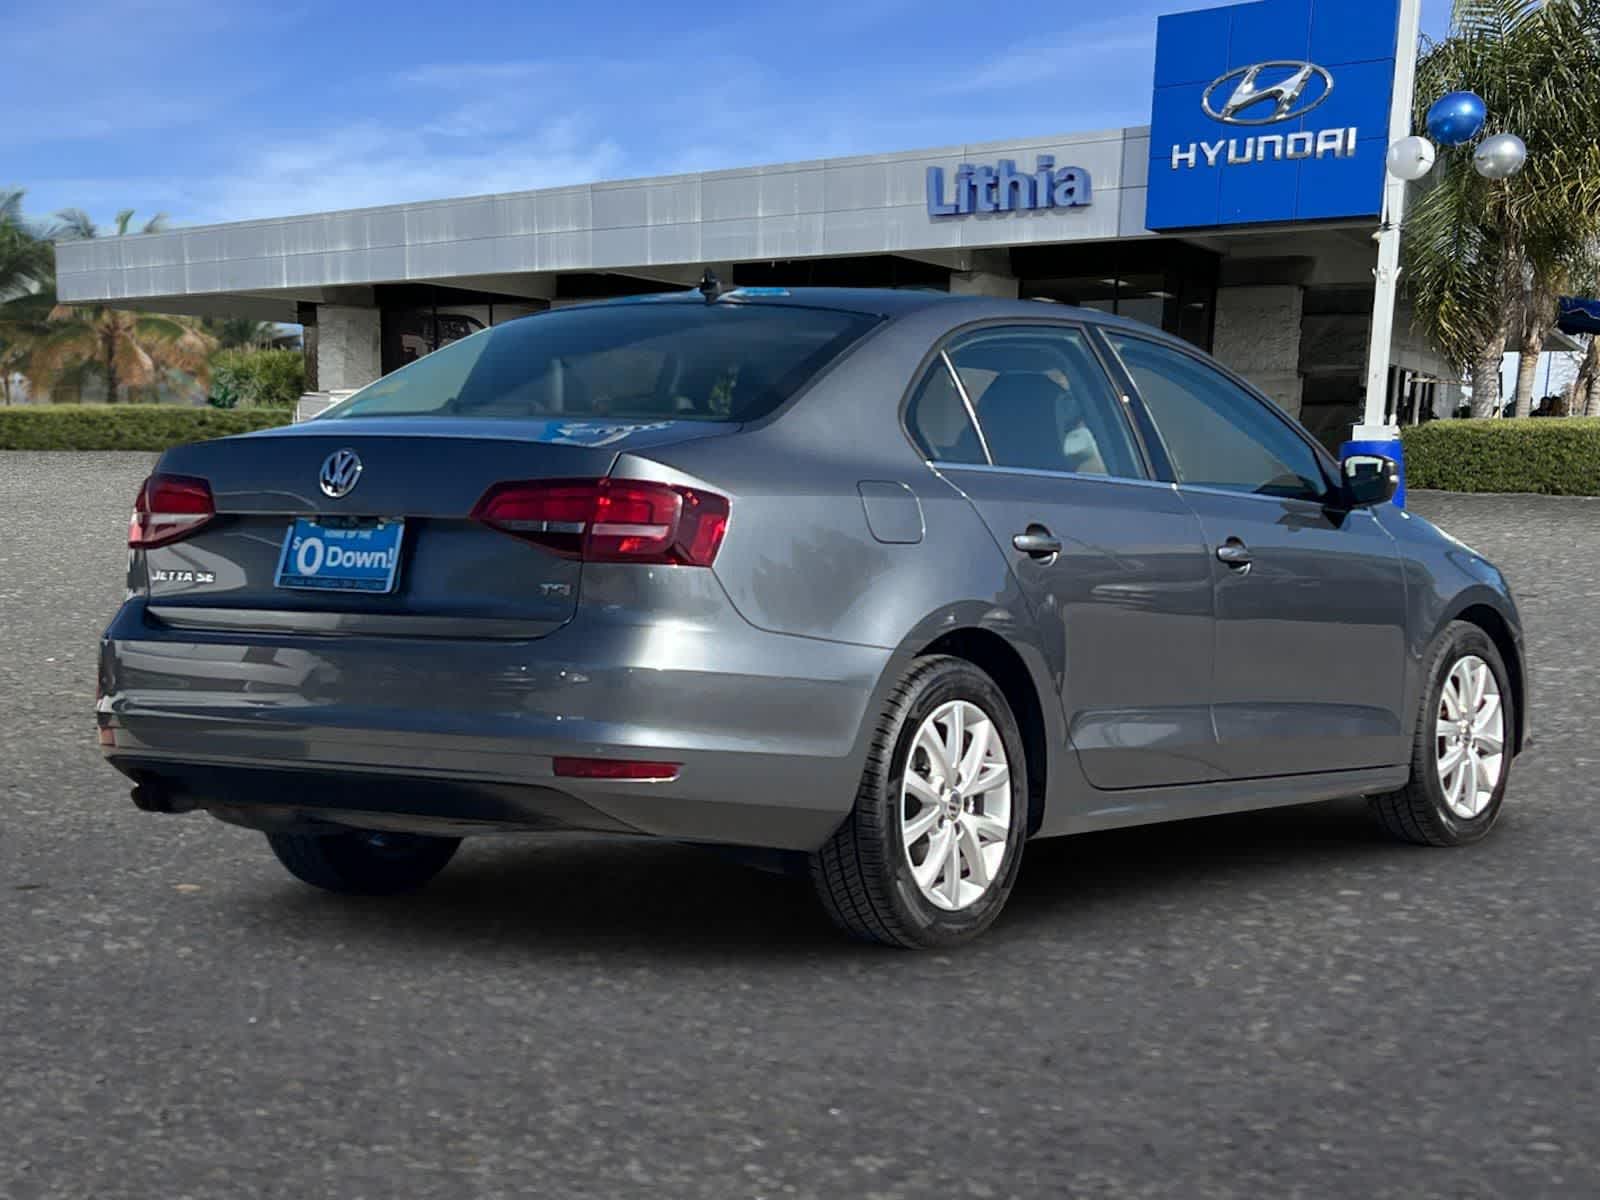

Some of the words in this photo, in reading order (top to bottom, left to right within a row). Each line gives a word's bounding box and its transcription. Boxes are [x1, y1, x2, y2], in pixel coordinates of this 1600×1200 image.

[1171, 127, 1357, 169] HYUNDAI
[926, 155, 1092, 217] Lithia
[326, 546, 394, 568] Down!
[151, 570, 193, 581] JETTA
[195, 572, 214, 583] SE
